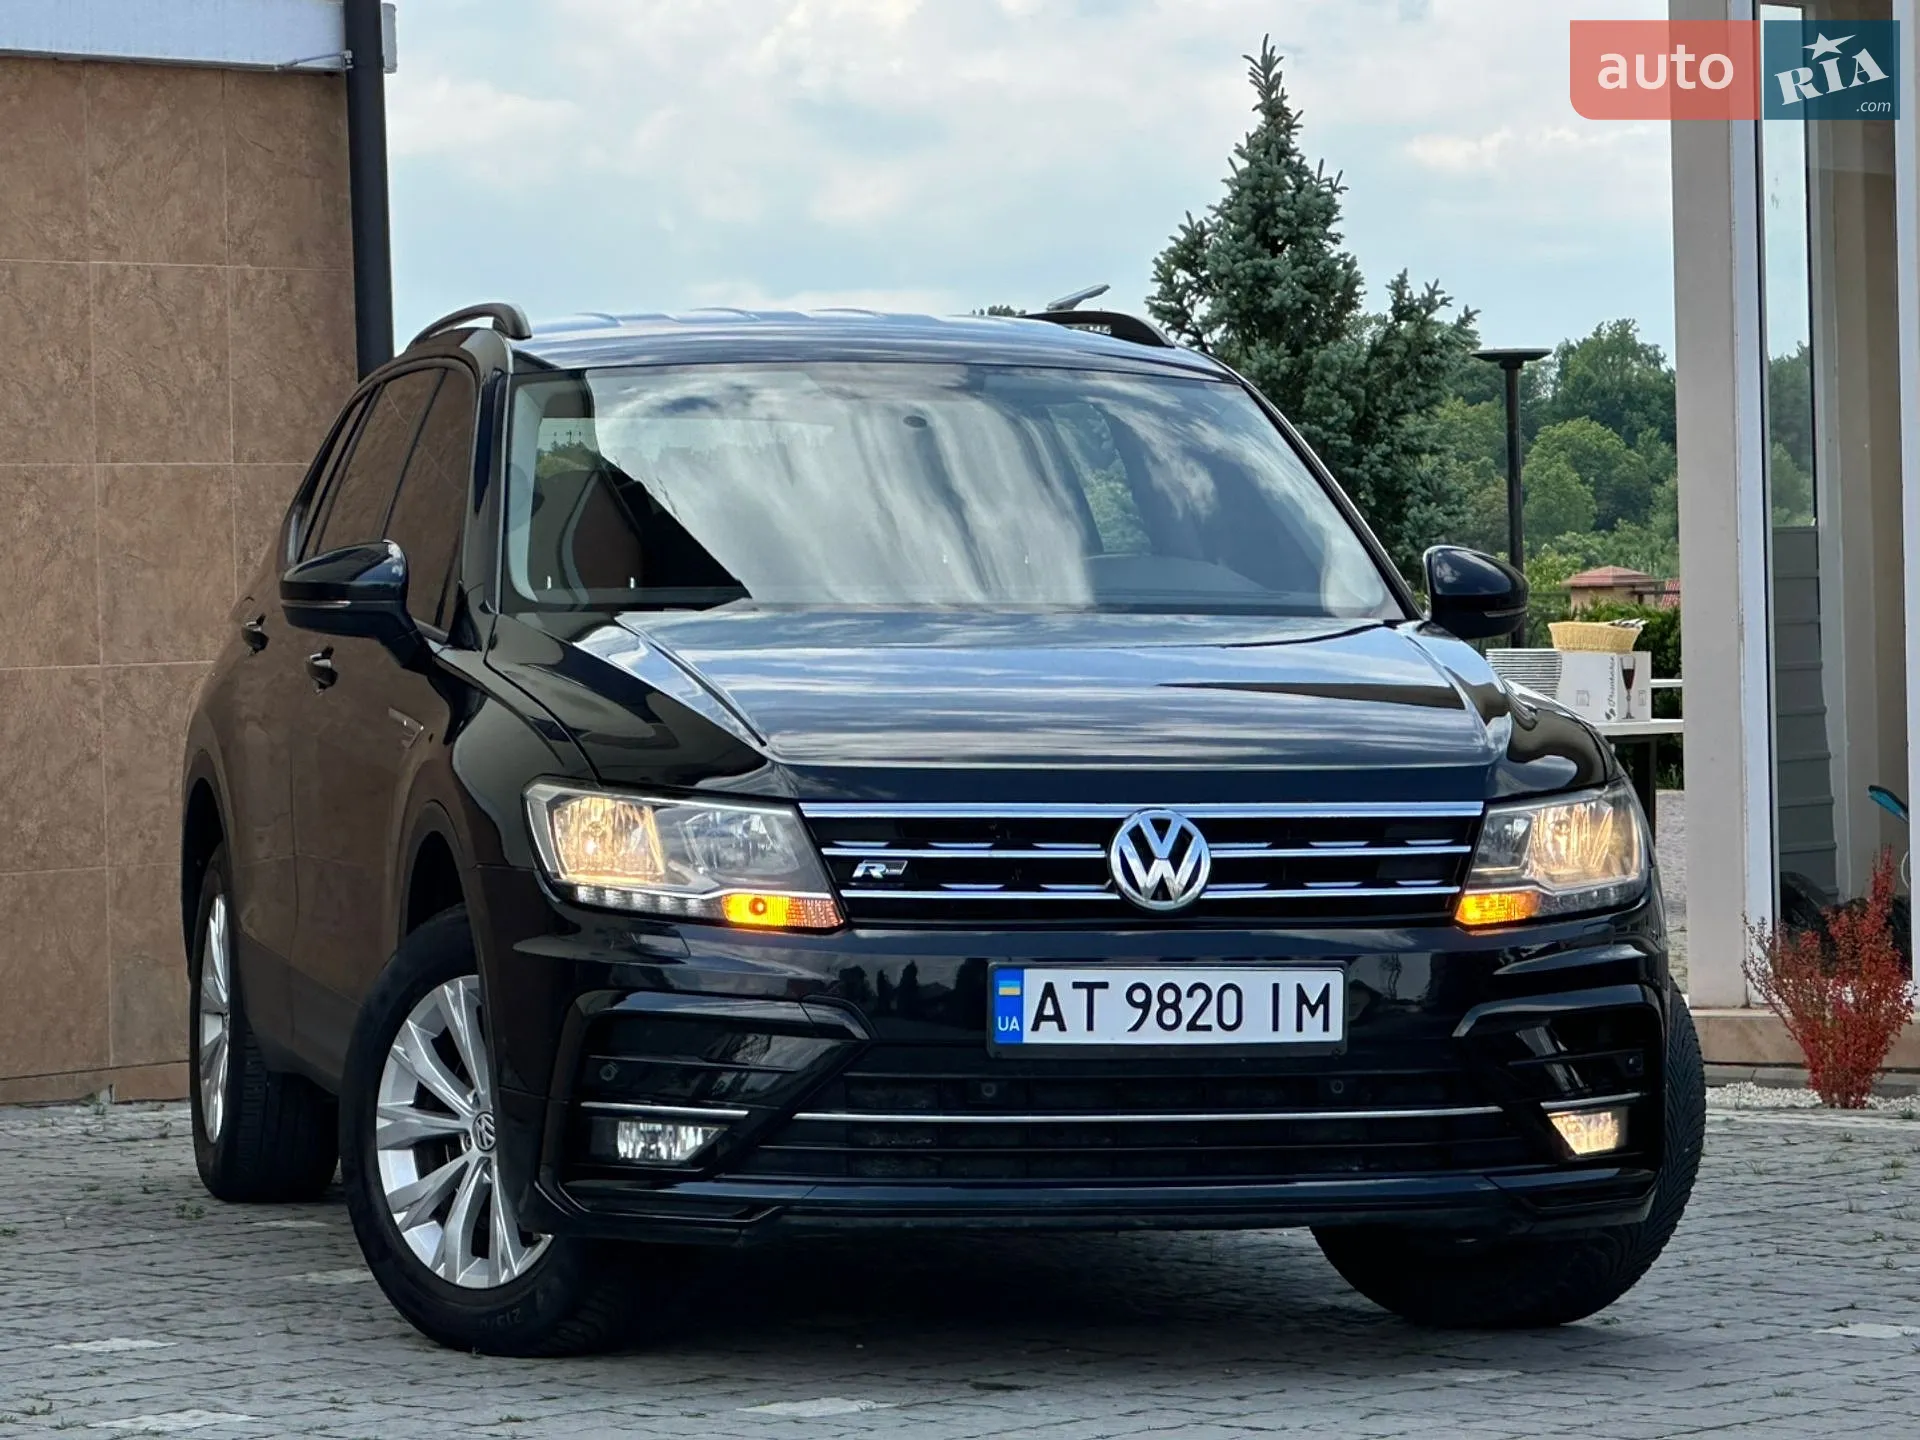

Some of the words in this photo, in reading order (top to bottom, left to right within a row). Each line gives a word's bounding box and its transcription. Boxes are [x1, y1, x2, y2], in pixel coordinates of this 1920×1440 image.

[1030, 981, 1109, 1032] AT
[1125, 982, 1244, 1032] 9820
[1272, 983, 1331, 1032] IM
[997, 1017, 1020, 1032] UA
